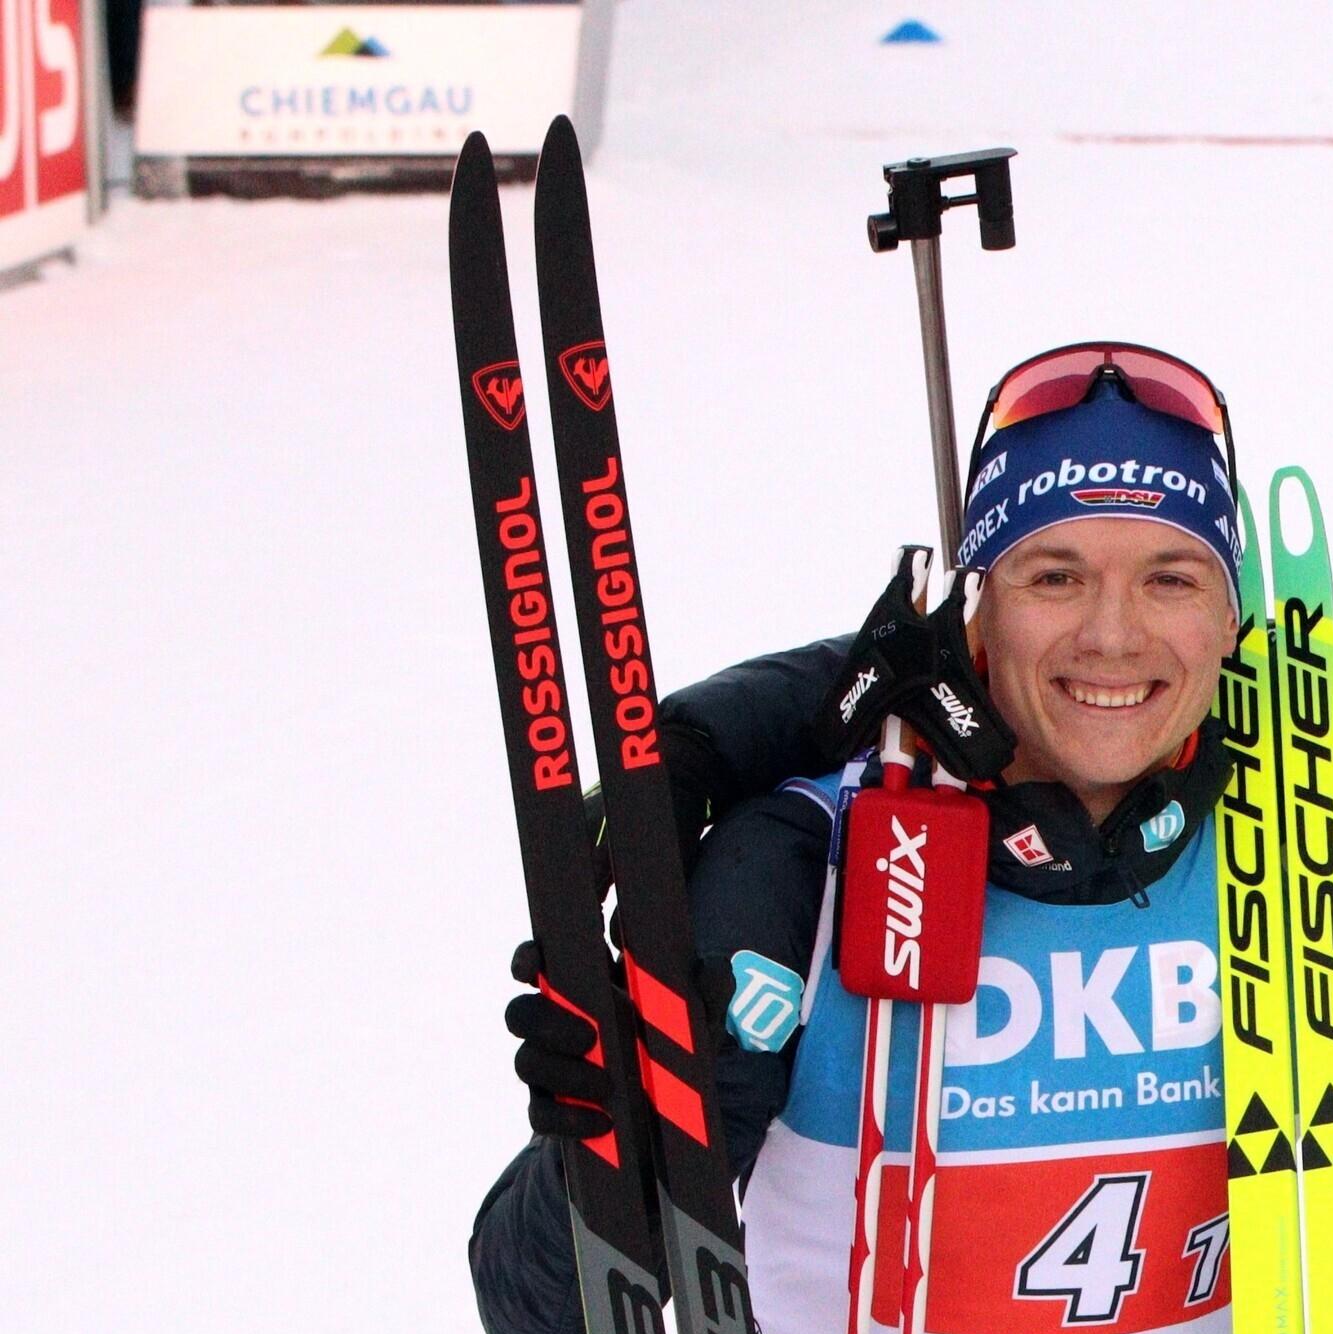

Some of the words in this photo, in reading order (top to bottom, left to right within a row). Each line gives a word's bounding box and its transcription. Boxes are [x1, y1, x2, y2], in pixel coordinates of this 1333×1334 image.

[240, 86, 473, 116] CHIEMGAU
[1018, 458, 1206, 504] robotron
[958, 498, 1009, 567] TERREX
[496, 477, 573, 791] ROSSIGNOL
[582, 457, 661, 769] ROSSIGNOL
[946, 940, 1222, 1067] DKB
[941, 1087, 1015, 1120] Das
[1031, 1081, 1122, 1115] kann
[1137, 1065, 1222, 1106] Bank
[1012, 1171, 1152, 1328] 4
[1182, 1213, 1230, 1308] 1
